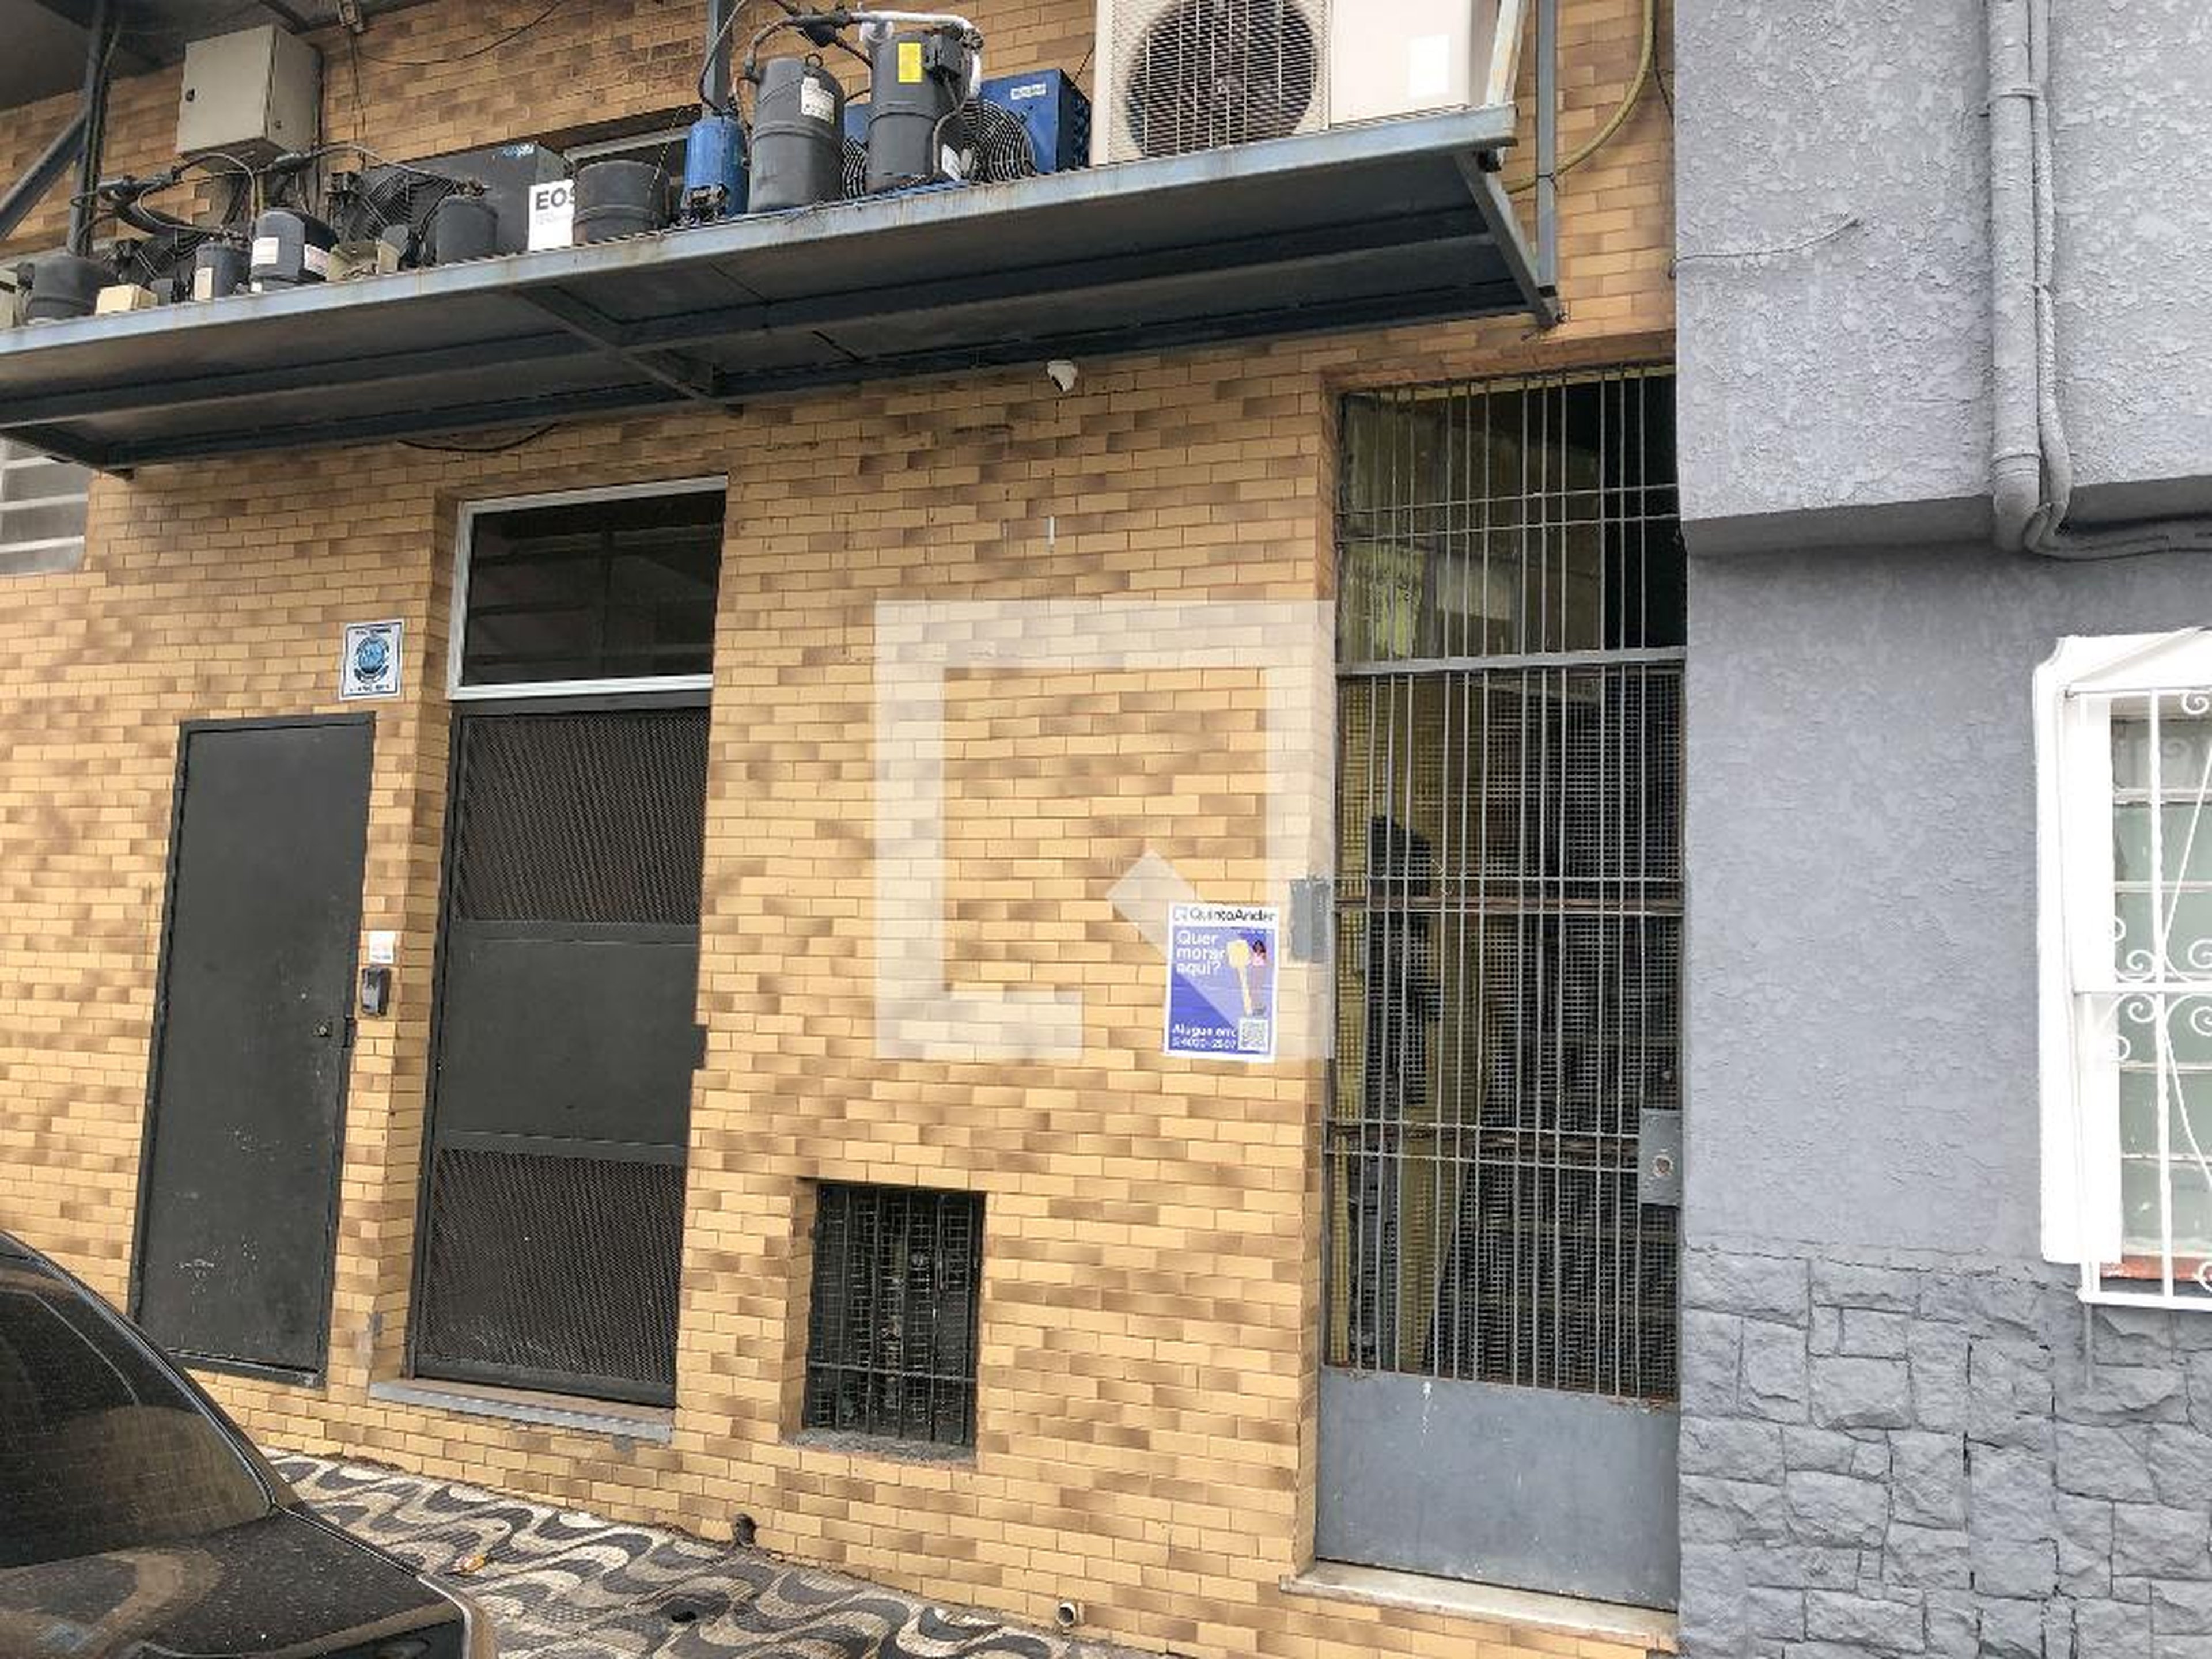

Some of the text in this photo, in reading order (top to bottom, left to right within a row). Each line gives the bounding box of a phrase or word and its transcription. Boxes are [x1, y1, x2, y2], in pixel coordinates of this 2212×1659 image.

[1177, 930, 1219, 946] Quer
[1176, 946, 1226, 960] morar
[1176, 960, 1221, 976] aqui?
